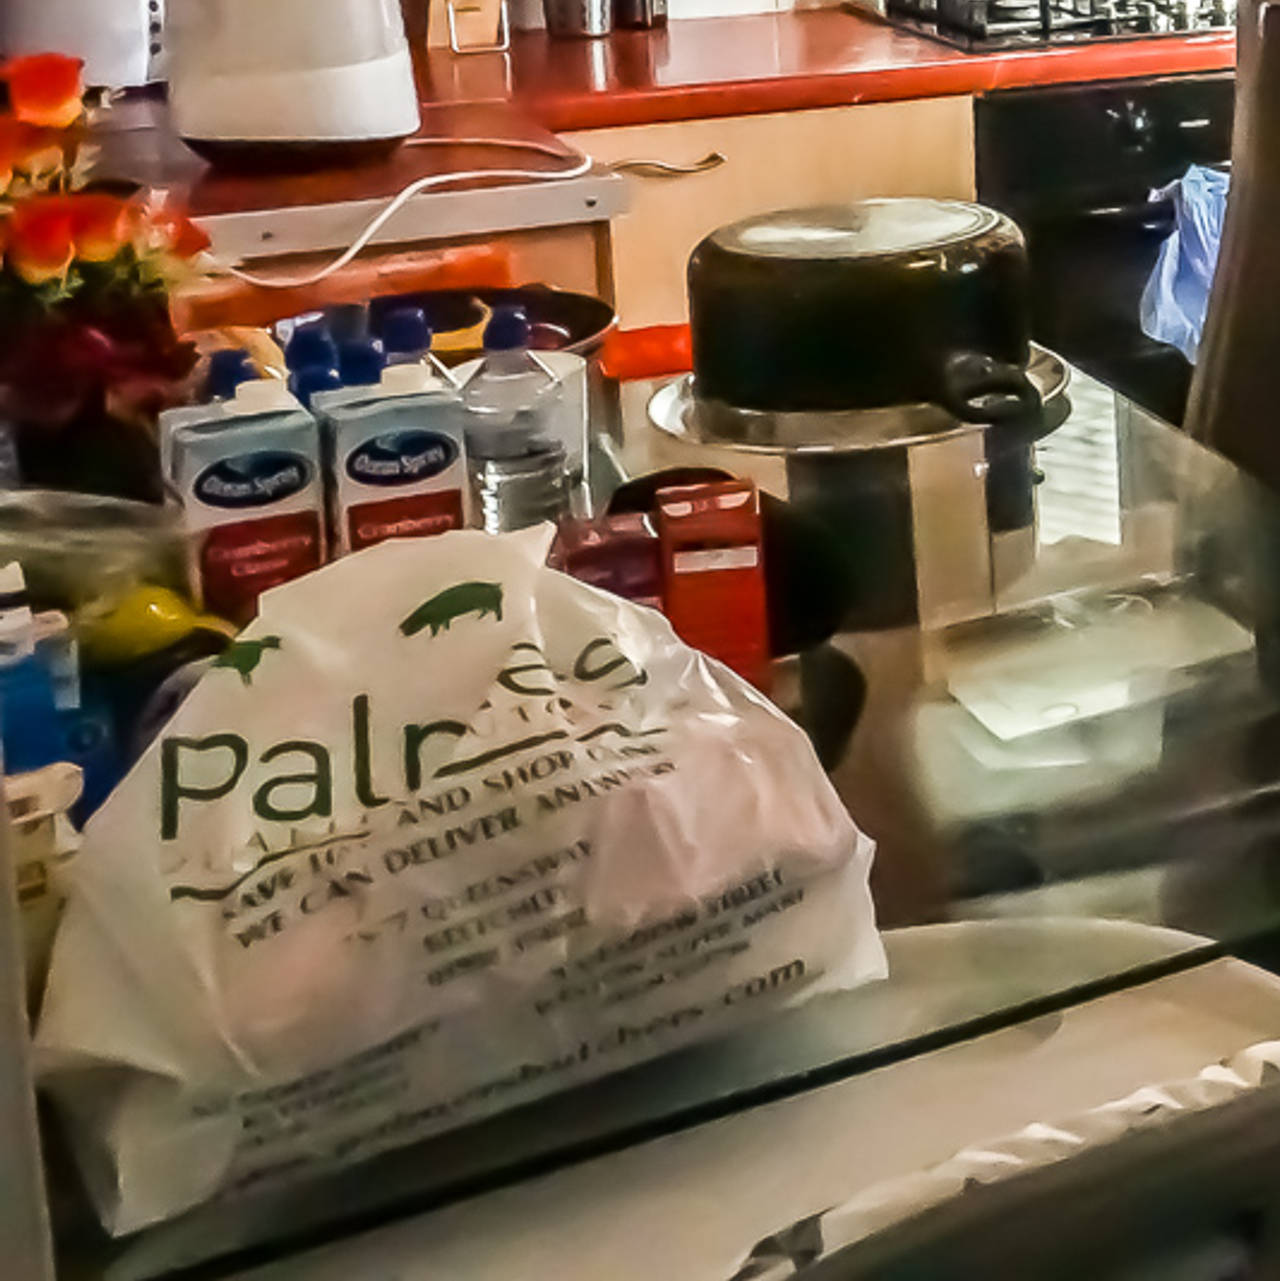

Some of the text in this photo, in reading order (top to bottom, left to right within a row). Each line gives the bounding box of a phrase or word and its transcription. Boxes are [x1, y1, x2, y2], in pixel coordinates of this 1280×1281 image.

[252, 466, 300, 496] Spray
[401, 445, 446, 474] Spray
[398, 786, 471, 827] AND
[482, 750, 574, 792] SHOP
[384, 805, 522, 874] DELIVER
